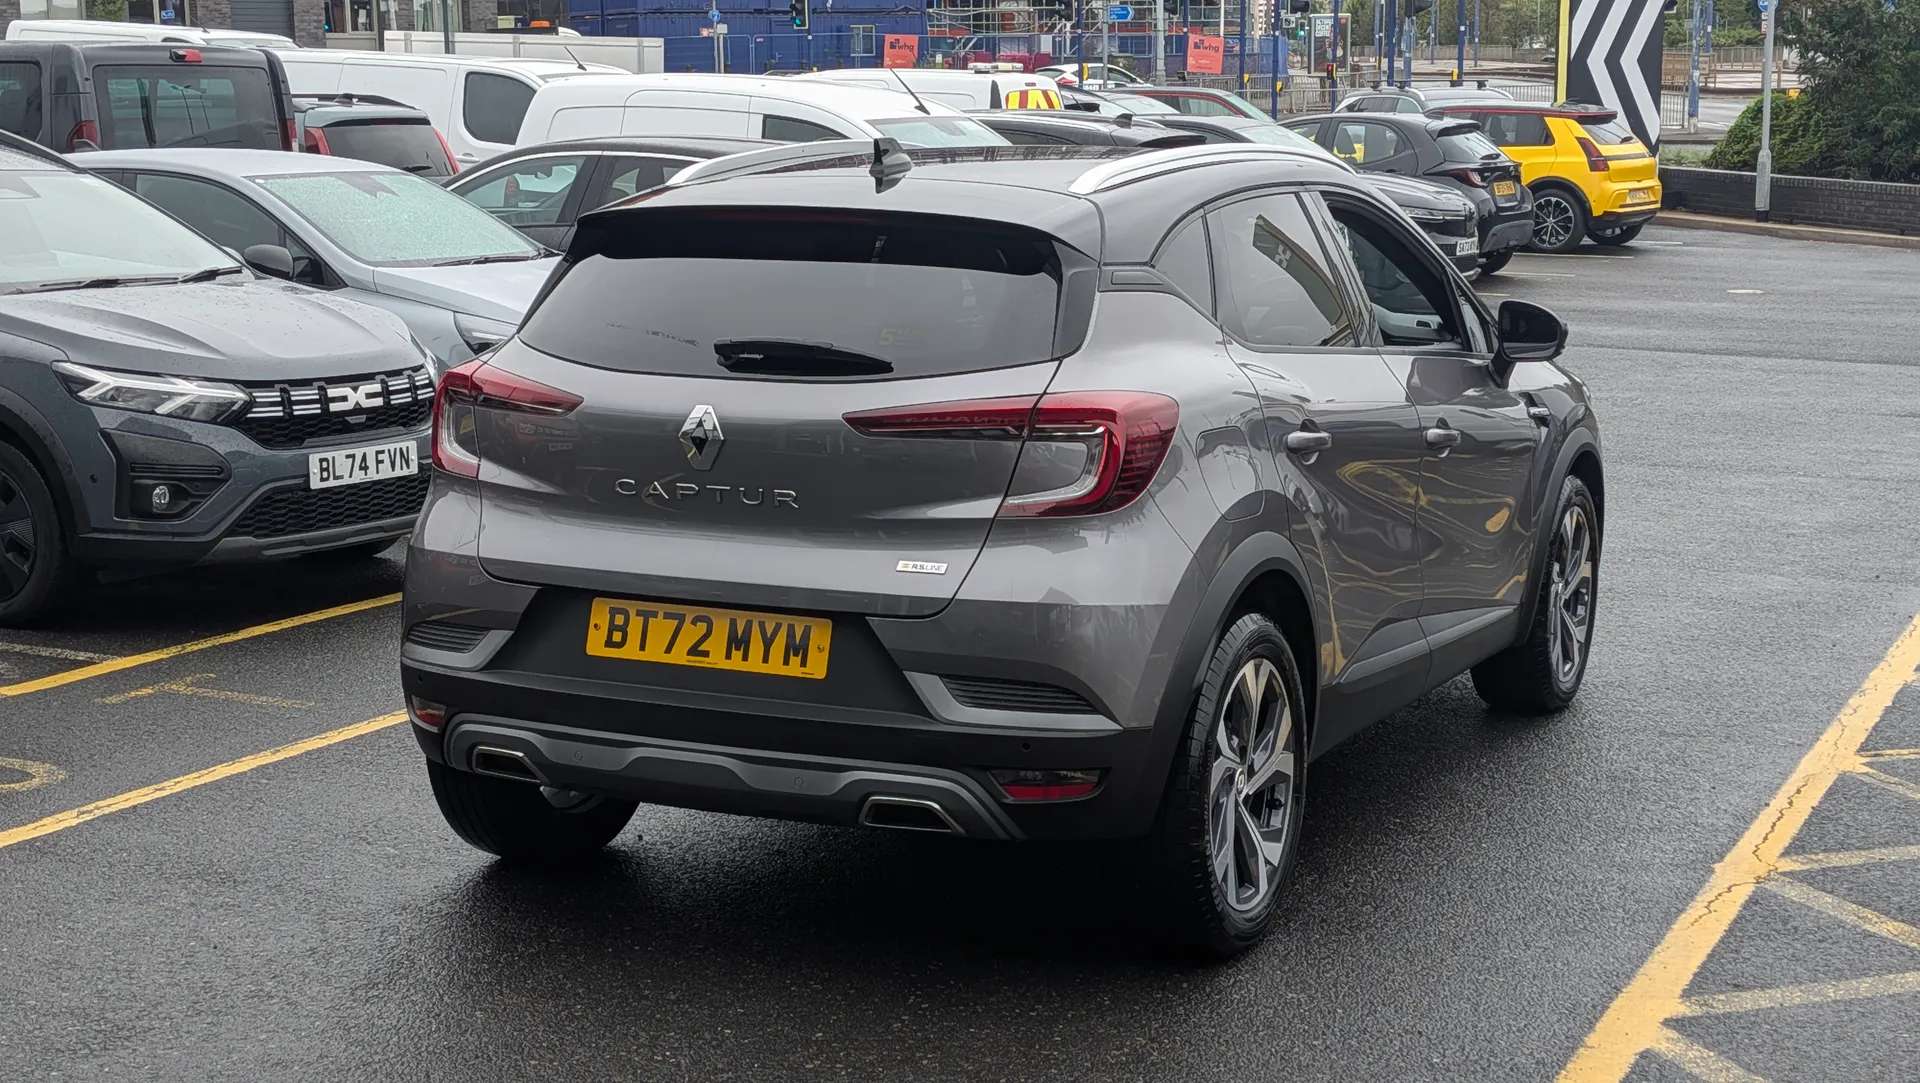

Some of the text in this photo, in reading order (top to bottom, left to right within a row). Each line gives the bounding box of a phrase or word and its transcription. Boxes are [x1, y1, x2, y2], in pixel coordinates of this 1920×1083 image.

[318, 446, 411, 482] BL74 FVN
[615, 478, 799, 509] CAPTUR
[604, 606, 812, 669] BT72 MYM
